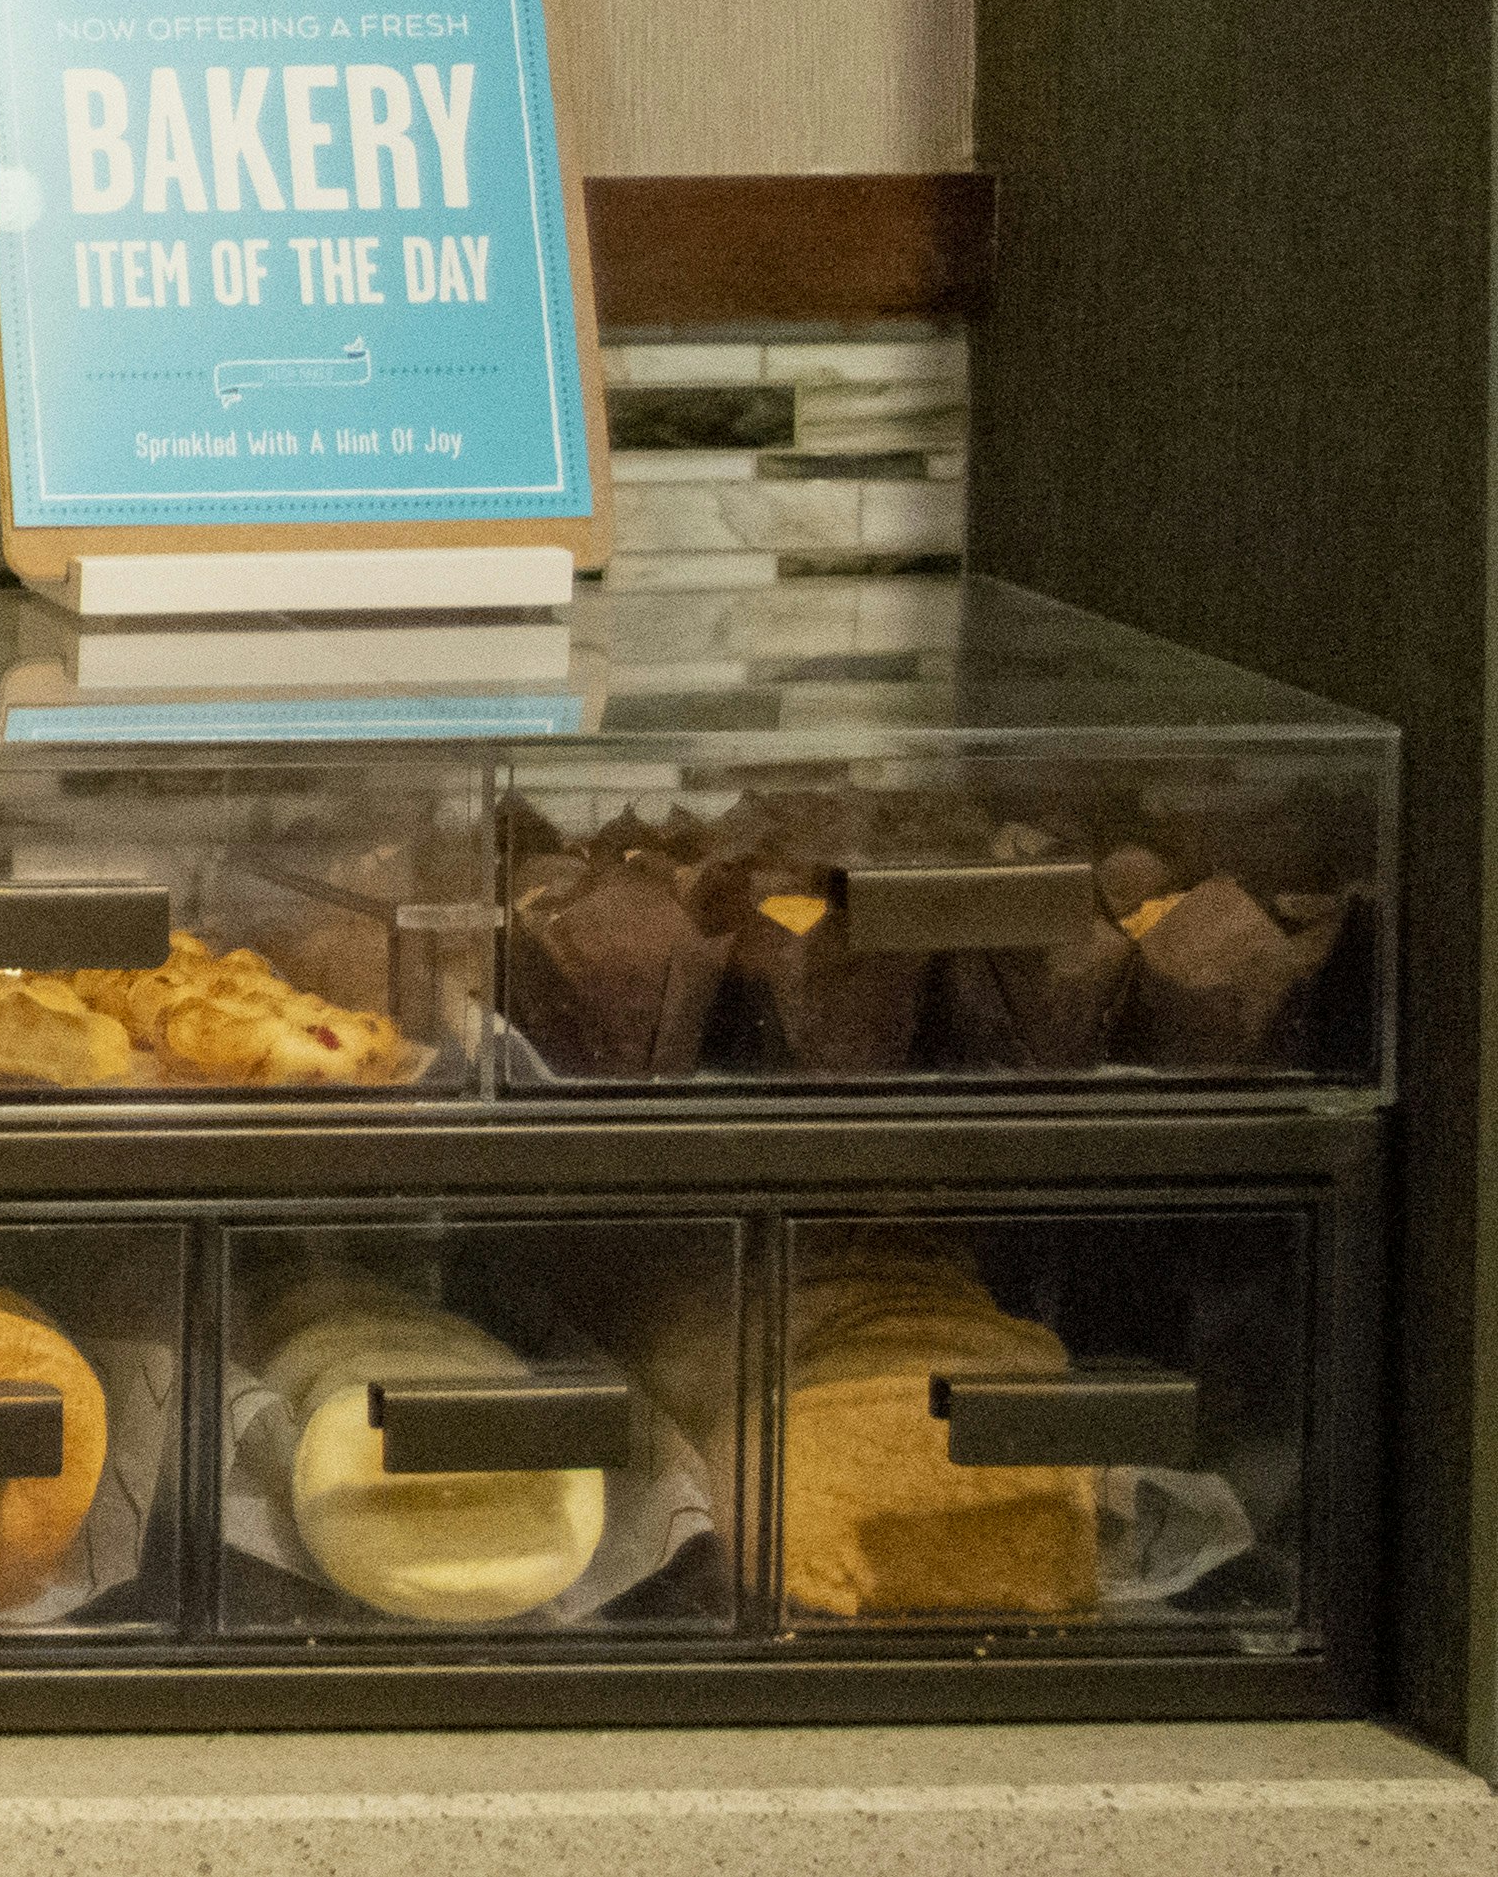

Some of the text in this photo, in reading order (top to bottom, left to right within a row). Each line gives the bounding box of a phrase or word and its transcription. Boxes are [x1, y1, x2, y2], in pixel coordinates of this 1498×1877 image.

[58, 13, 470, 42] NOW OFFERING A FRESH
[62, 63, 475, 215] BAKERY
[75, 236, 490, 308] ITEM OF THE DAY
[136, 427, 463, 464] Sprinkled With A Hint Of Joy
